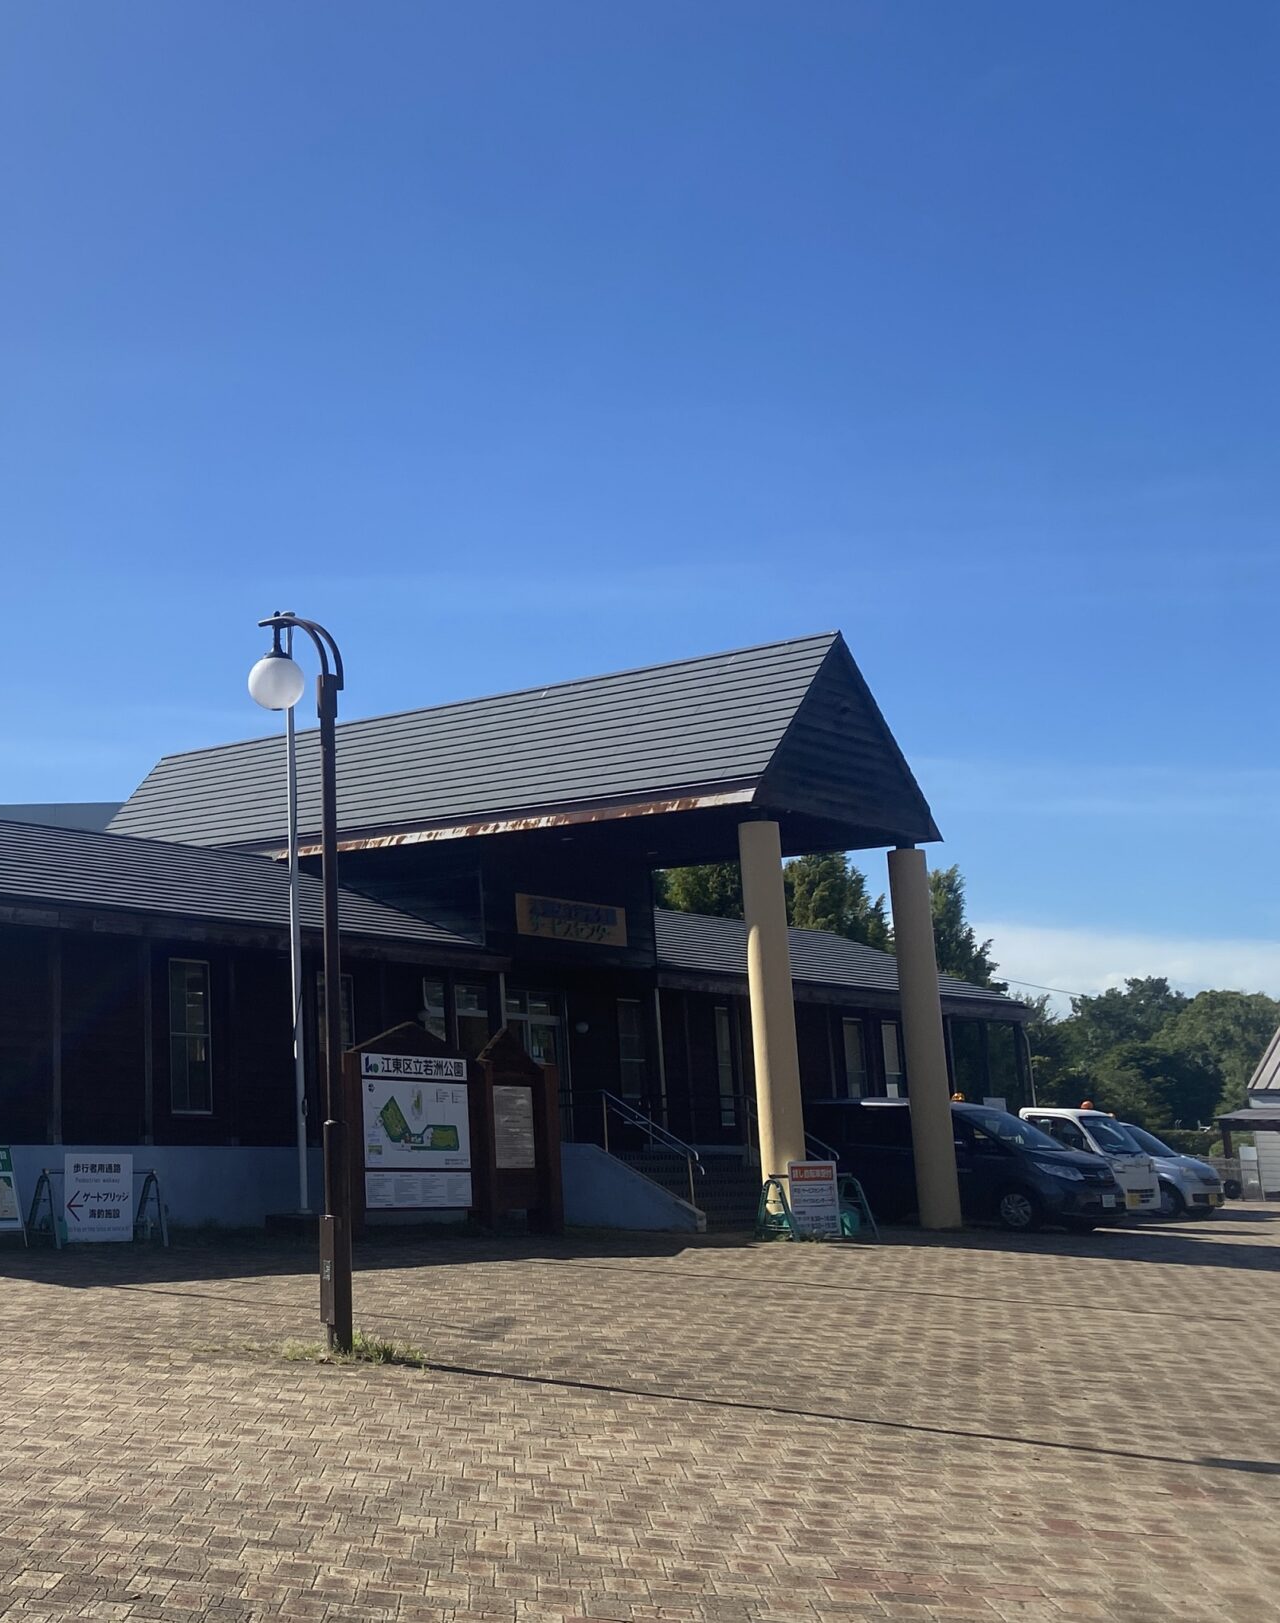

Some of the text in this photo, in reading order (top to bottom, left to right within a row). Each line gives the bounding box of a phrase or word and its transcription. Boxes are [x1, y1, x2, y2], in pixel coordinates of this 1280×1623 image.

[381, 1057, 464, 1077] 江東区立若洲公園
[73, 1163, 121, 1174] 歩行者用通路
[82, 1190, 129, 1202] ゲートブリッジ
